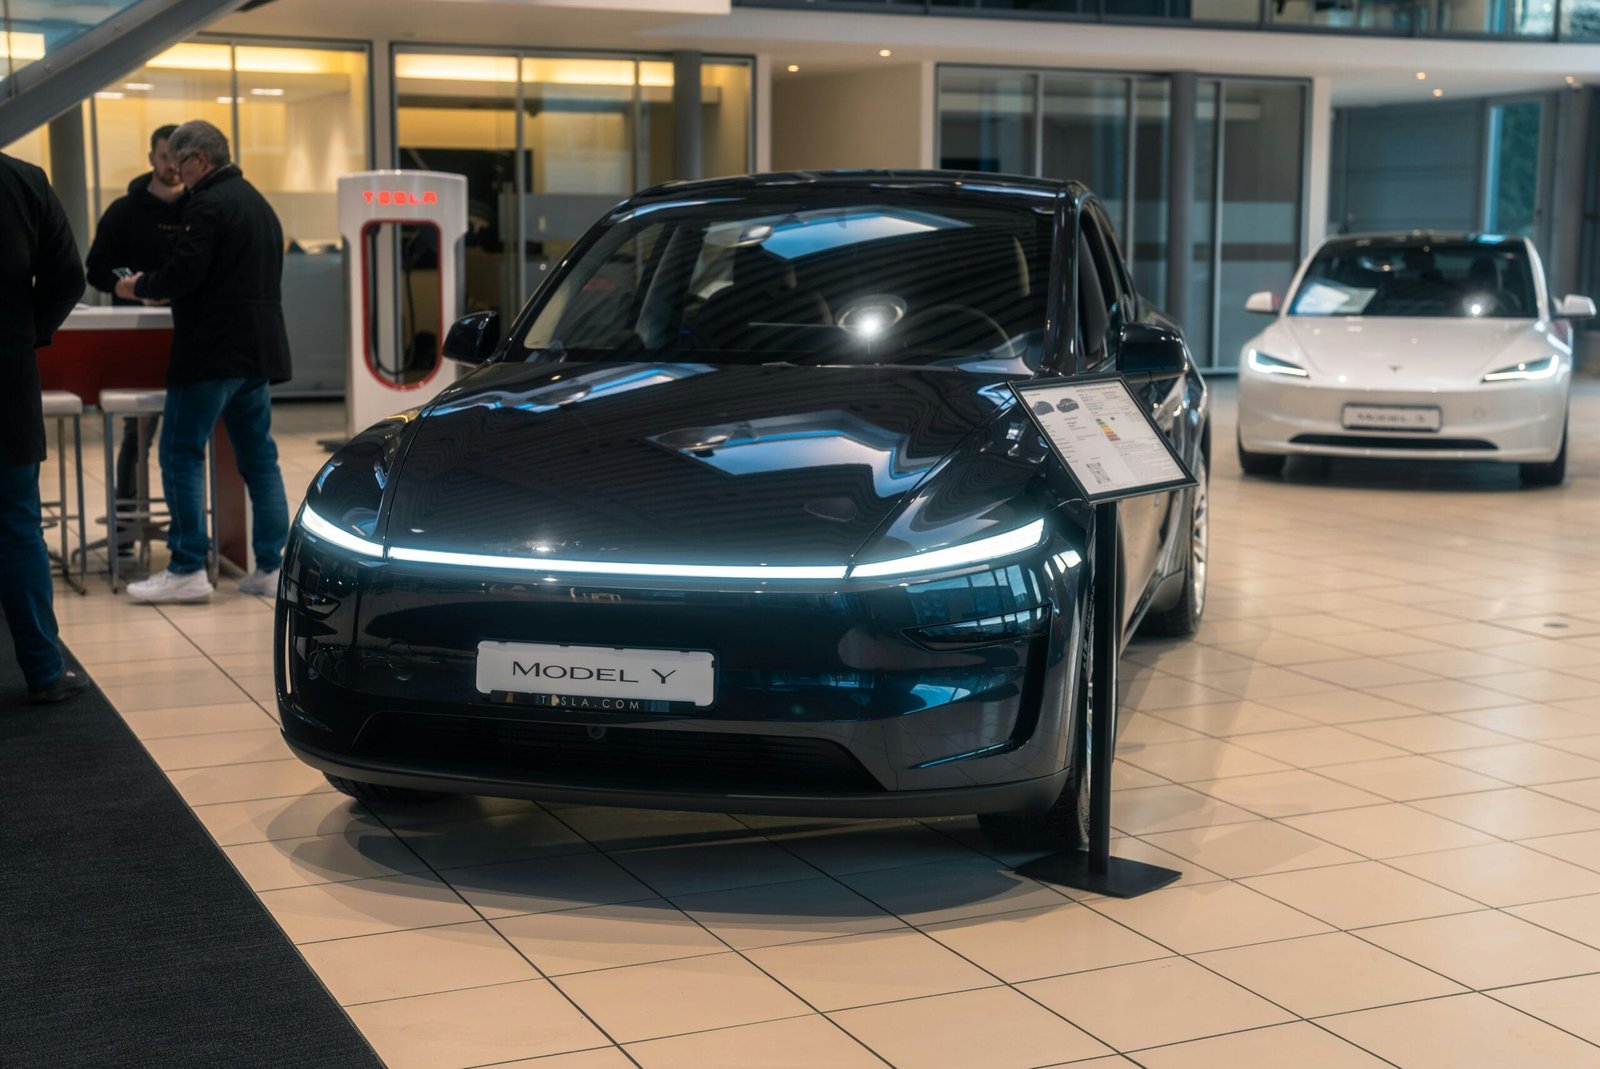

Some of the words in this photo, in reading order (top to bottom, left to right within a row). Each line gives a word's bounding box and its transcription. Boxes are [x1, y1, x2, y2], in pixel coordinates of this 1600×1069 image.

[512, 660, 640, 684] MODEL
[650, 668, 677, 685] Y
[540, 694, 641, 710] TSLA.COM
